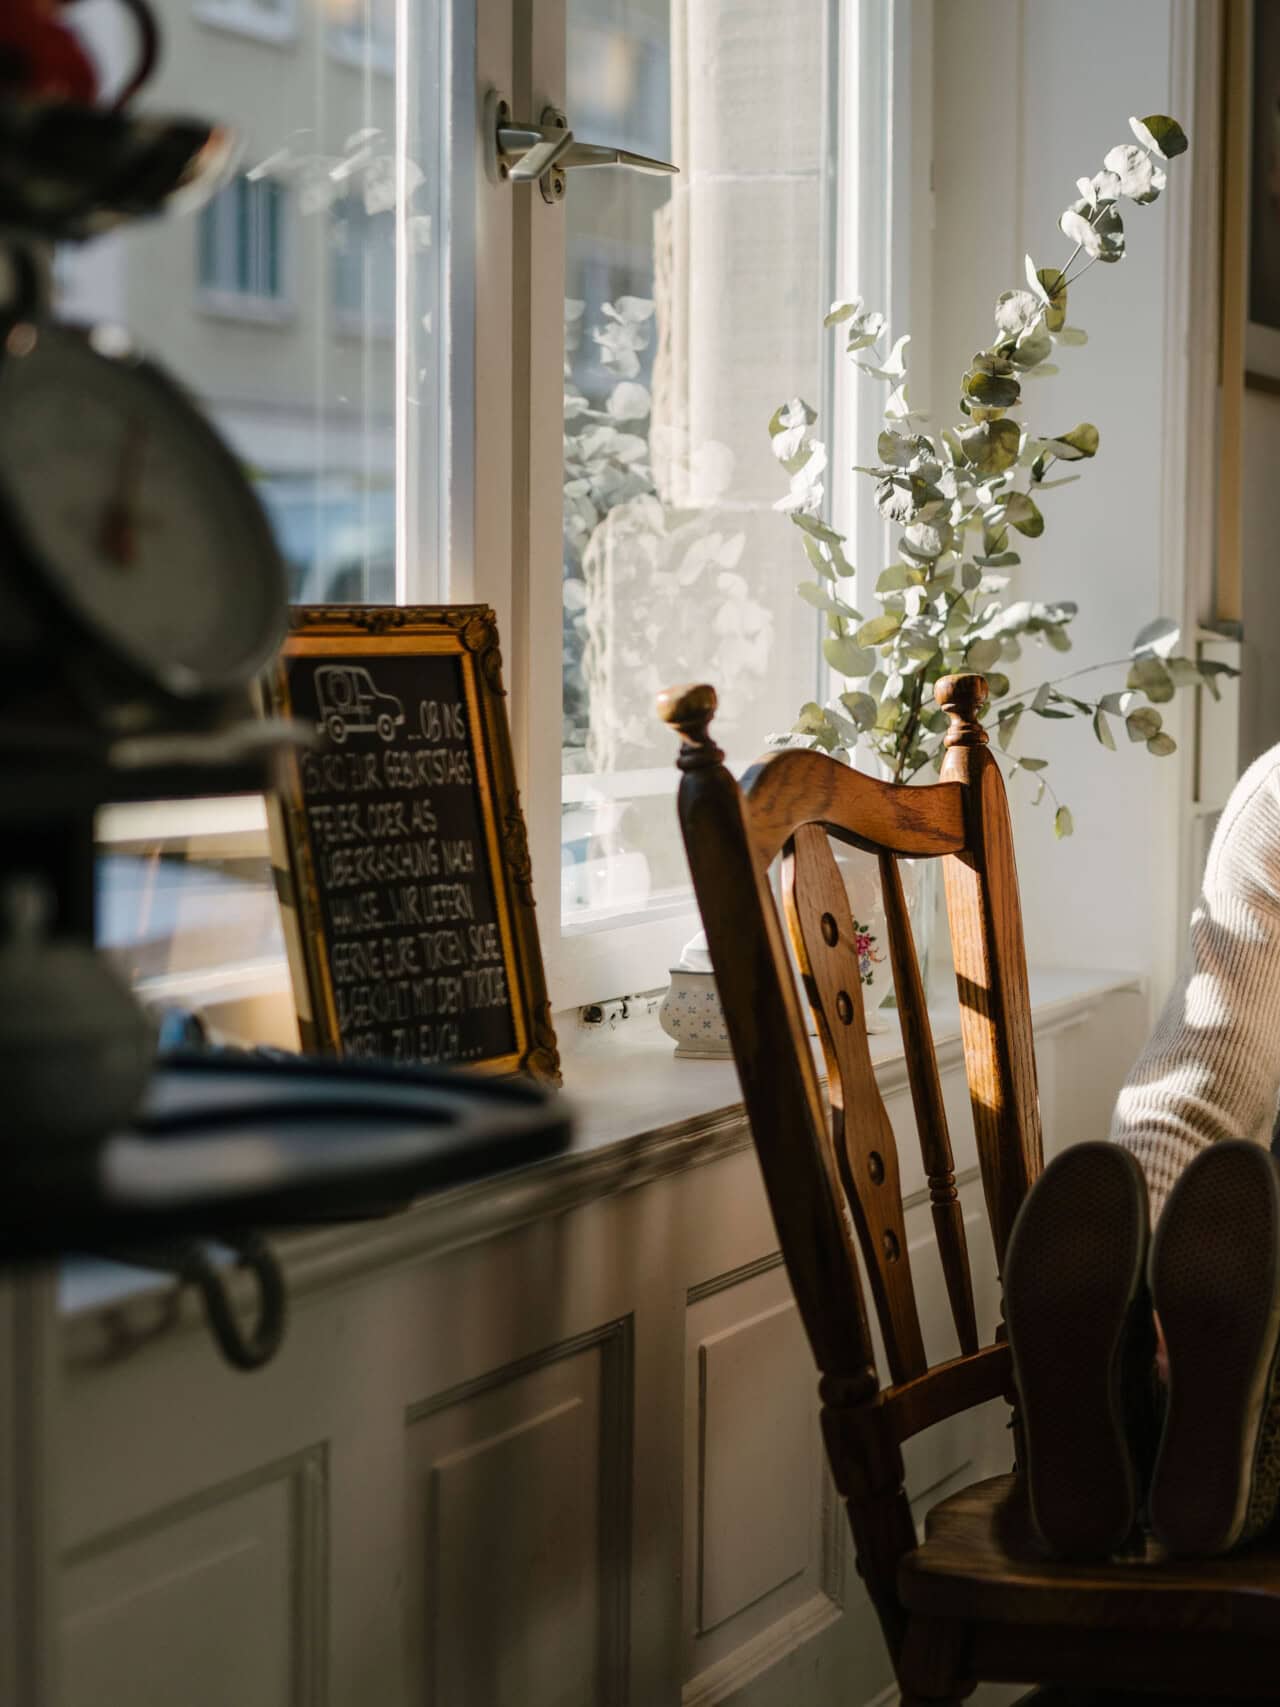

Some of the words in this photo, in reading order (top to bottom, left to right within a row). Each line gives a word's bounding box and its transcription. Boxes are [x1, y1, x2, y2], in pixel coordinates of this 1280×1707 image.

[442, 702, 467, 741] INS
[308, 802, 369, 843] FEIER
[367, 801, 411, 836] ODER
[411, 798, 439, 833] ALS
[440, 838, 475, 877] NACH
[421, 881, 475, 925] LIEFERN
[331, 941, 383, 983] GERNE
[382, 936, 422, 977] EURE
[412, 976, 437, 1017] MIT
[436, 975, 467, 1016] DEM
